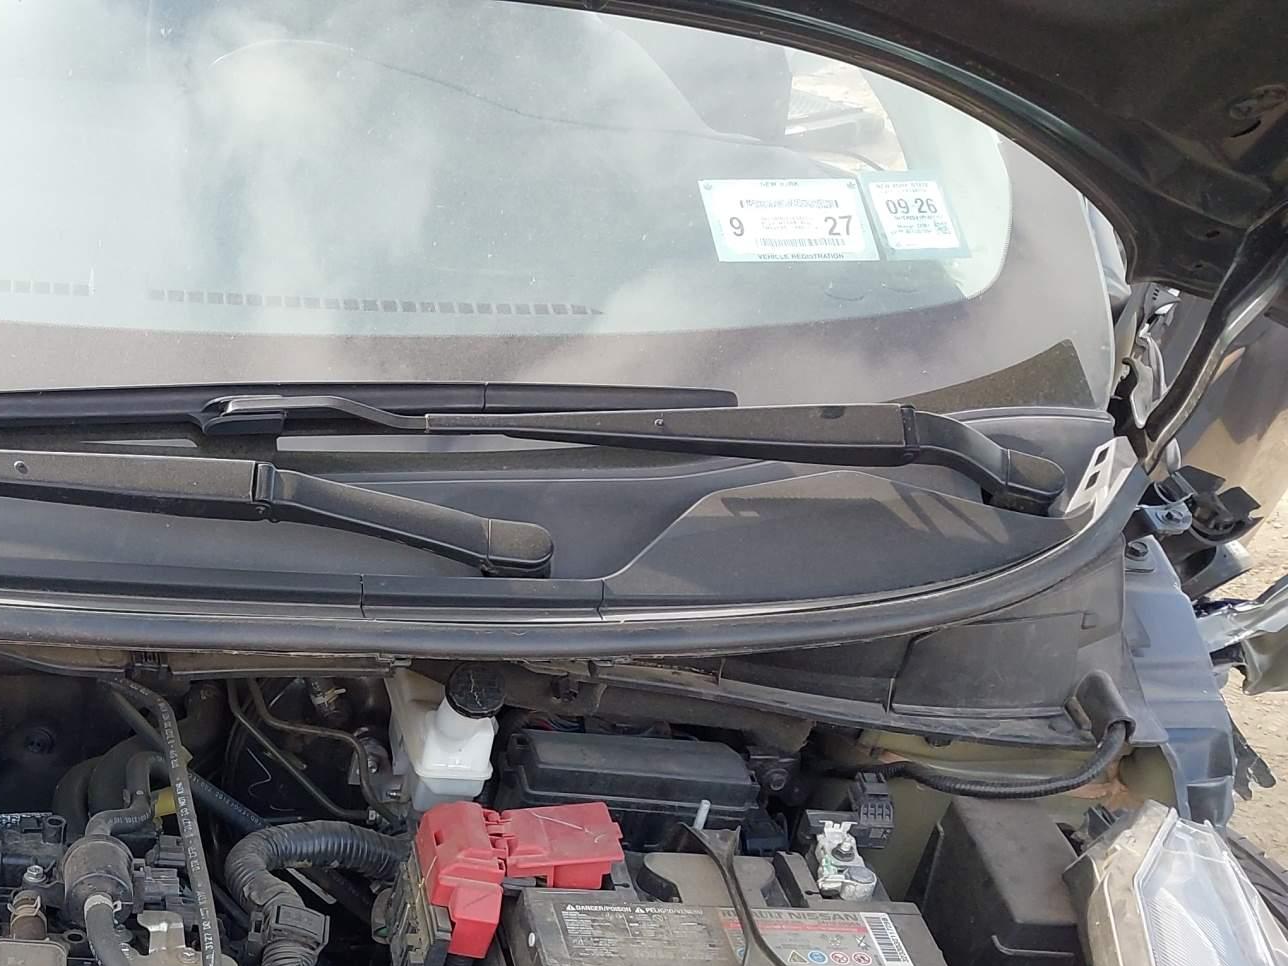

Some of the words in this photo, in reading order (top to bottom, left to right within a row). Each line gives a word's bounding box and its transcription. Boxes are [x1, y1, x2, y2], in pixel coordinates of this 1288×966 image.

[729, 216, 745, 237] 9
[824, 215, 853, 236] 27
[789, 912, 860, 922] NISSAN
